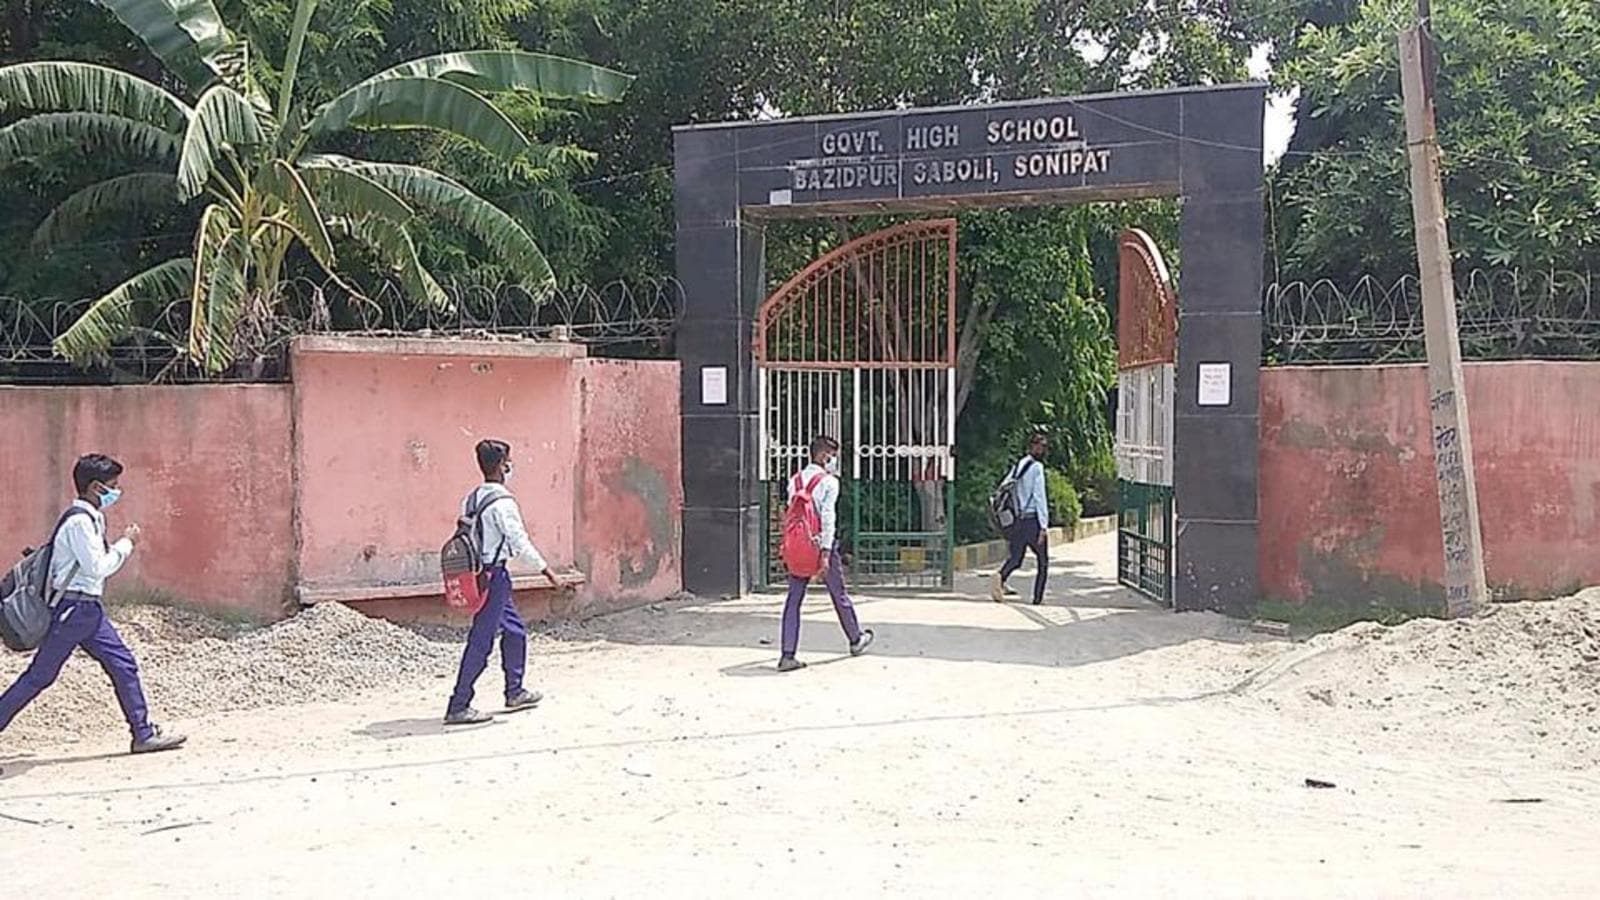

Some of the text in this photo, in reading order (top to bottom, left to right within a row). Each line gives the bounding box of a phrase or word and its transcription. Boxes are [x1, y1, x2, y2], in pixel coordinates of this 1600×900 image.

[823, 116, 1079, 154] GOVT. HIGH SCHOOL
[794, 149, 1111, 189] BAZIDPUR SABOLI, SONIPAT
